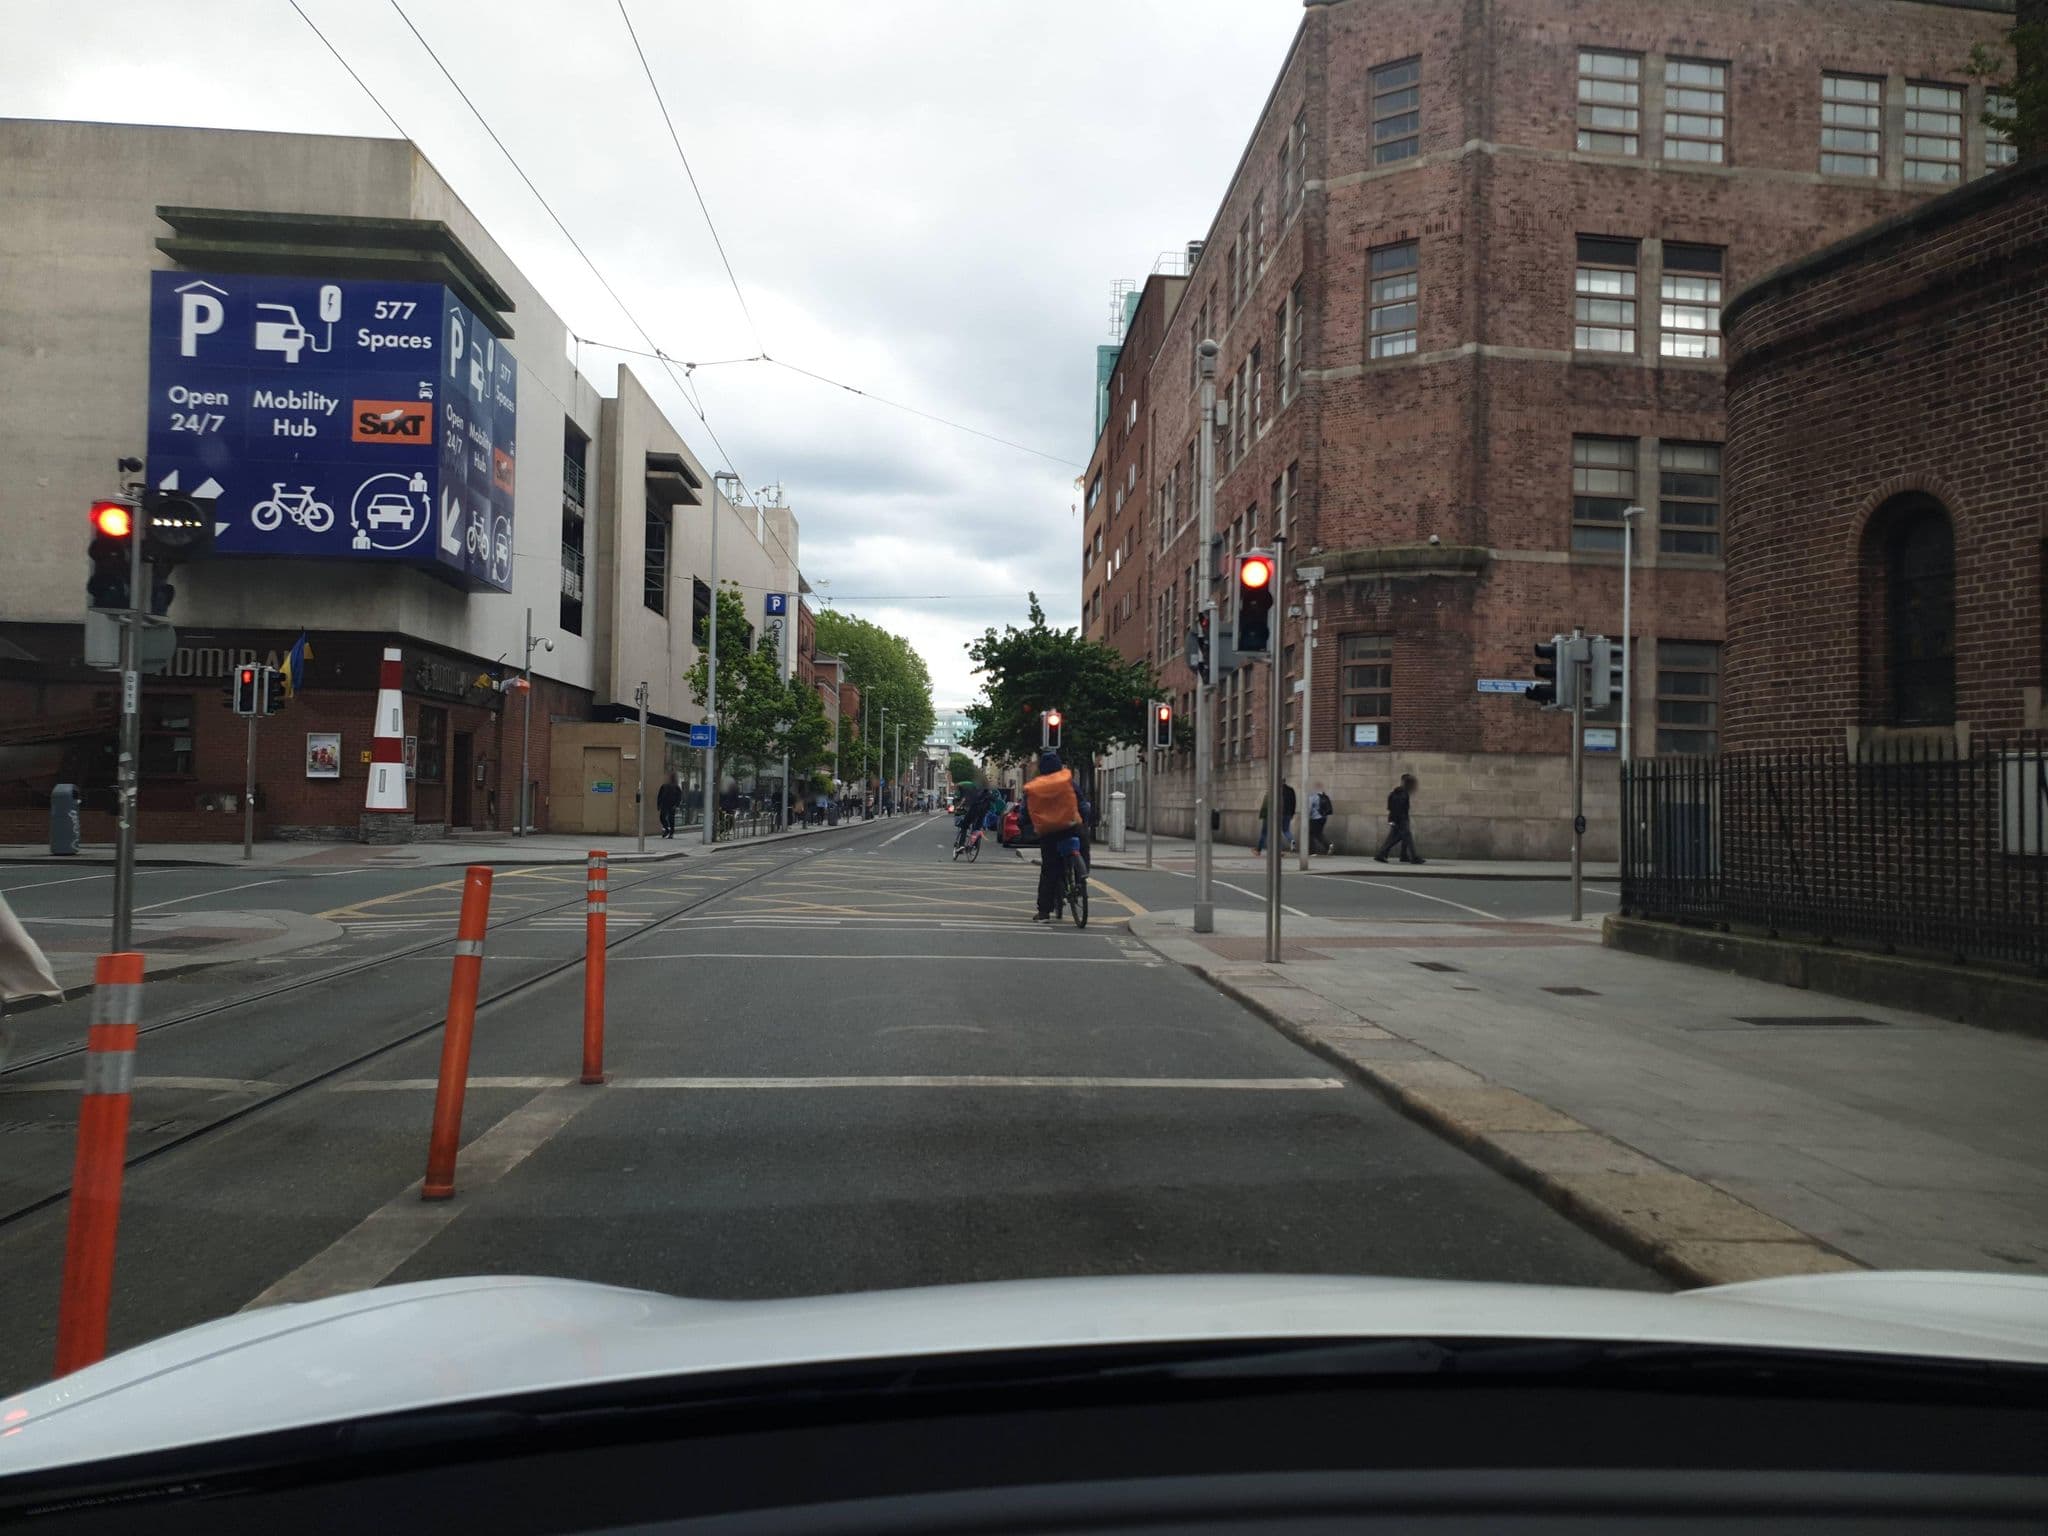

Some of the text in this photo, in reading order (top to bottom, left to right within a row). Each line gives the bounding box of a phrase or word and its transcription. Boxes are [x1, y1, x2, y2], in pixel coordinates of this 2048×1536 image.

[374, 301, 417, 320] 577
[181, 294, 225, 357] P
[357, 329, 433, 352] Spaces
[168, 386, 229, 408] Open
[253, 390, 339, 416] Mobility
[170, 413, 225, 436] 24/7
[273, 418, 318, 438] Hub
[446, 404, 464, 431] Open
